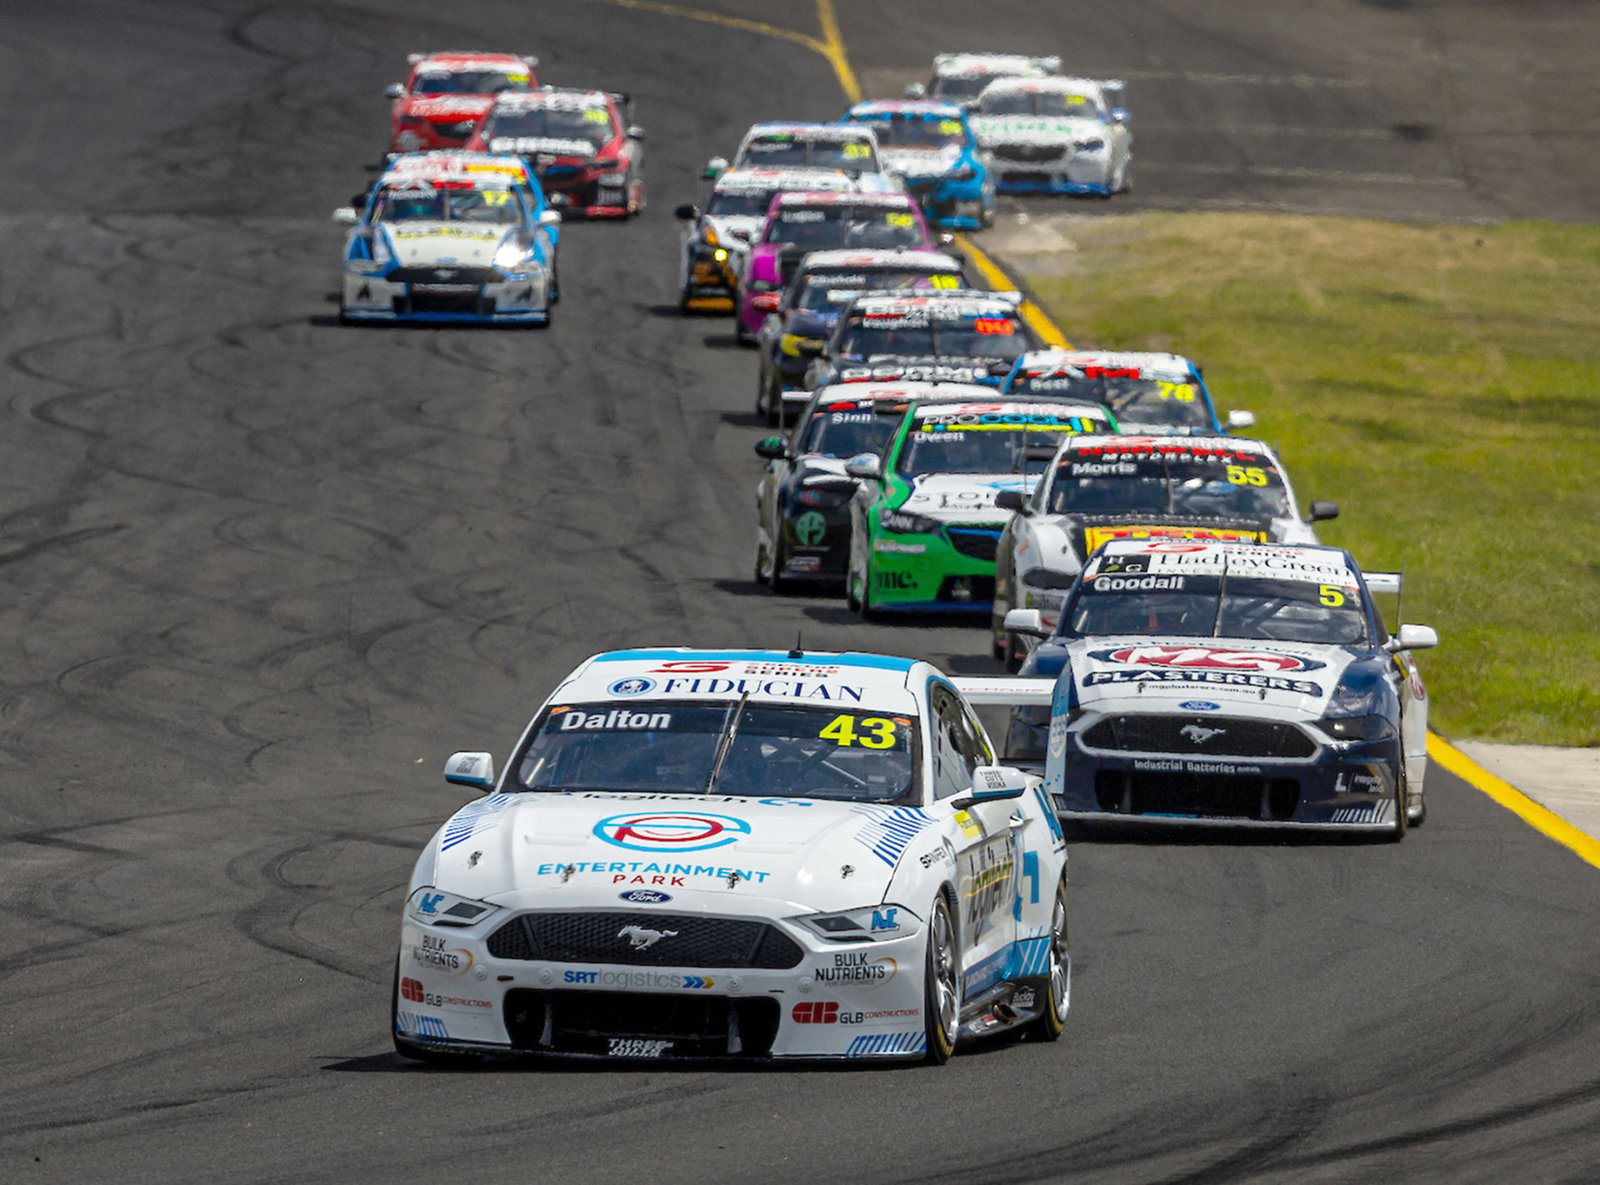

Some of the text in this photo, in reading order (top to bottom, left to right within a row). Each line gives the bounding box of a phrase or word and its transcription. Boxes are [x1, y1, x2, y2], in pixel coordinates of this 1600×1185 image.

[914, 431, 964, 443] Owen
[1072, 461, 1137, 476] Morris
[1226, 465, 1268, 487] 55
[1093, 575, 1184, 592] Goodall
[1318, 584, 1345, 607] 5
[664, 677, 867, 702] FIDUCIAN
[1091, 670, 1312, 693] PLASTERERS
[559, 708, 672, 732] Dalton
[818, 714, 897, 749] 43
[1134, 759, 1183, 771] Industrial
[1187, 761, 1235, 774] Batteries
[536, 861, 771, 884] ENTERTAINMENT
[611, 874, 685, 888] PARK
[422, 935, 447, 952] BULK
[413, 947, 460, 969] NUTRIENTS
[834, 952, 868, 967] BULK
[814, 964, 886, 982] NUTRIENTS
[425, 993, 443, 1007] GLB
[839, 1011, 864, 1024] GLB
[864, 1008, 919, 1020] CONSTRUCTIONS
